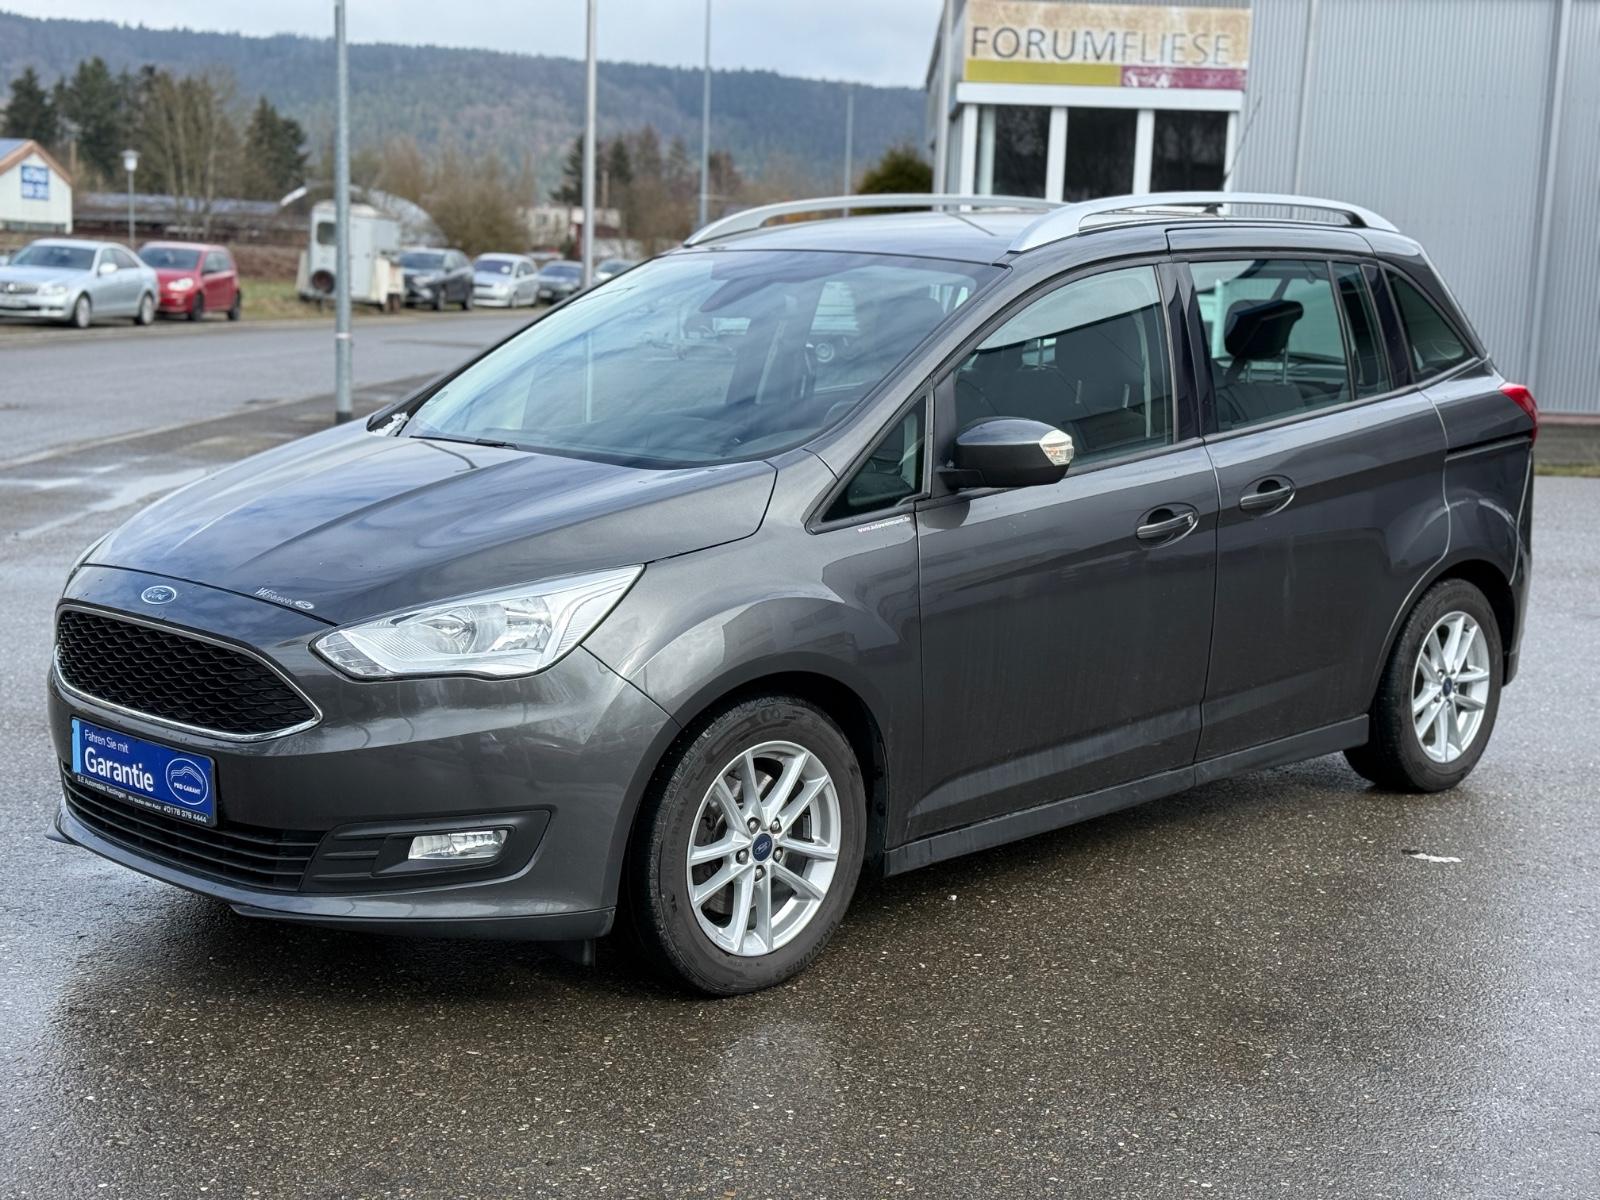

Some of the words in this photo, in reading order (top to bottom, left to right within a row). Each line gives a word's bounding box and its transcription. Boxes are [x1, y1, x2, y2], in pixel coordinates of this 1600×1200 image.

[84, 729, 106, 745] Fahren
[106, 737, 117, 749] Sie
[117, 742, 129, 754] mit
[84, 747, 154, 792] Garantie
